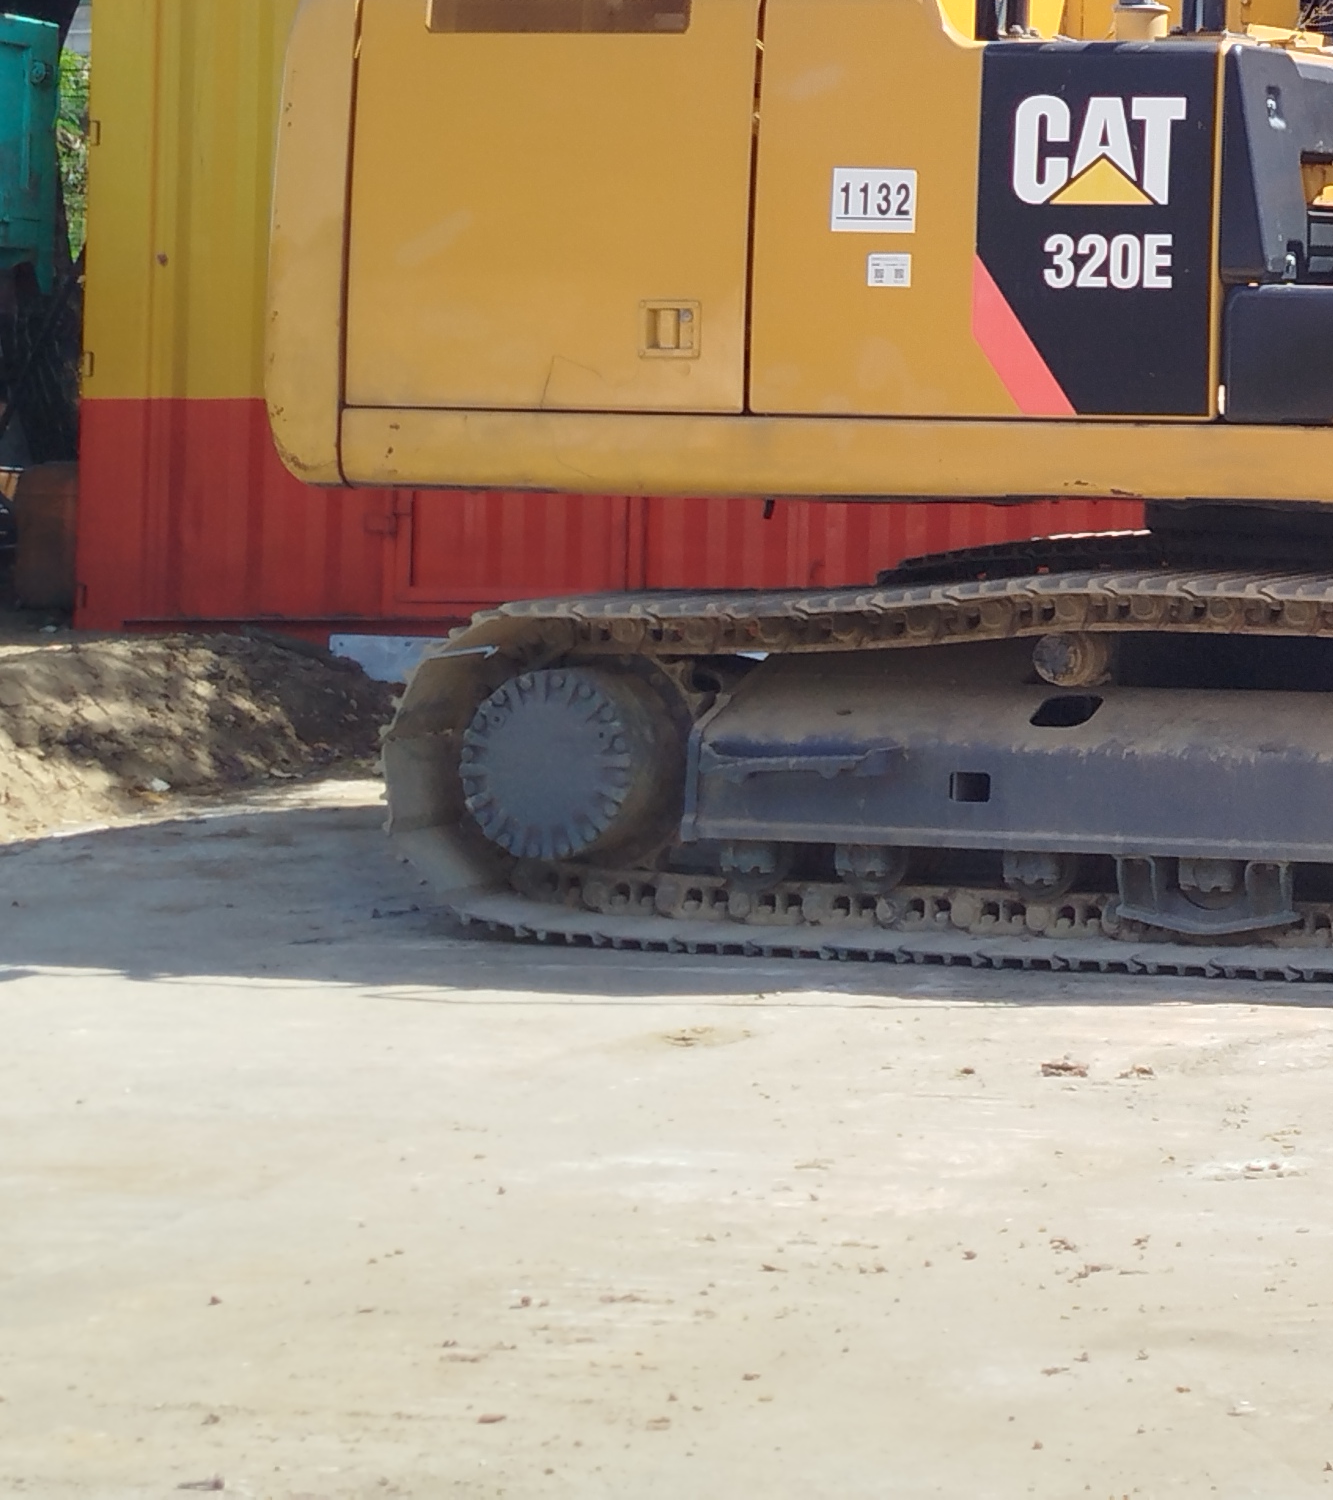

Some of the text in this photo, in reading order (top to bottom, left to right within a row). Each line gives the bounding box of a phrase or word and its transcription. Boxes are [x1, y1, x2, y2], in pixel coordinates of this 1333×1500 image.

[1012, 94, 1188, 206] CAT
[840, 181, 911, 217] 1132
[1042, 232, 1174, 290] 320E
